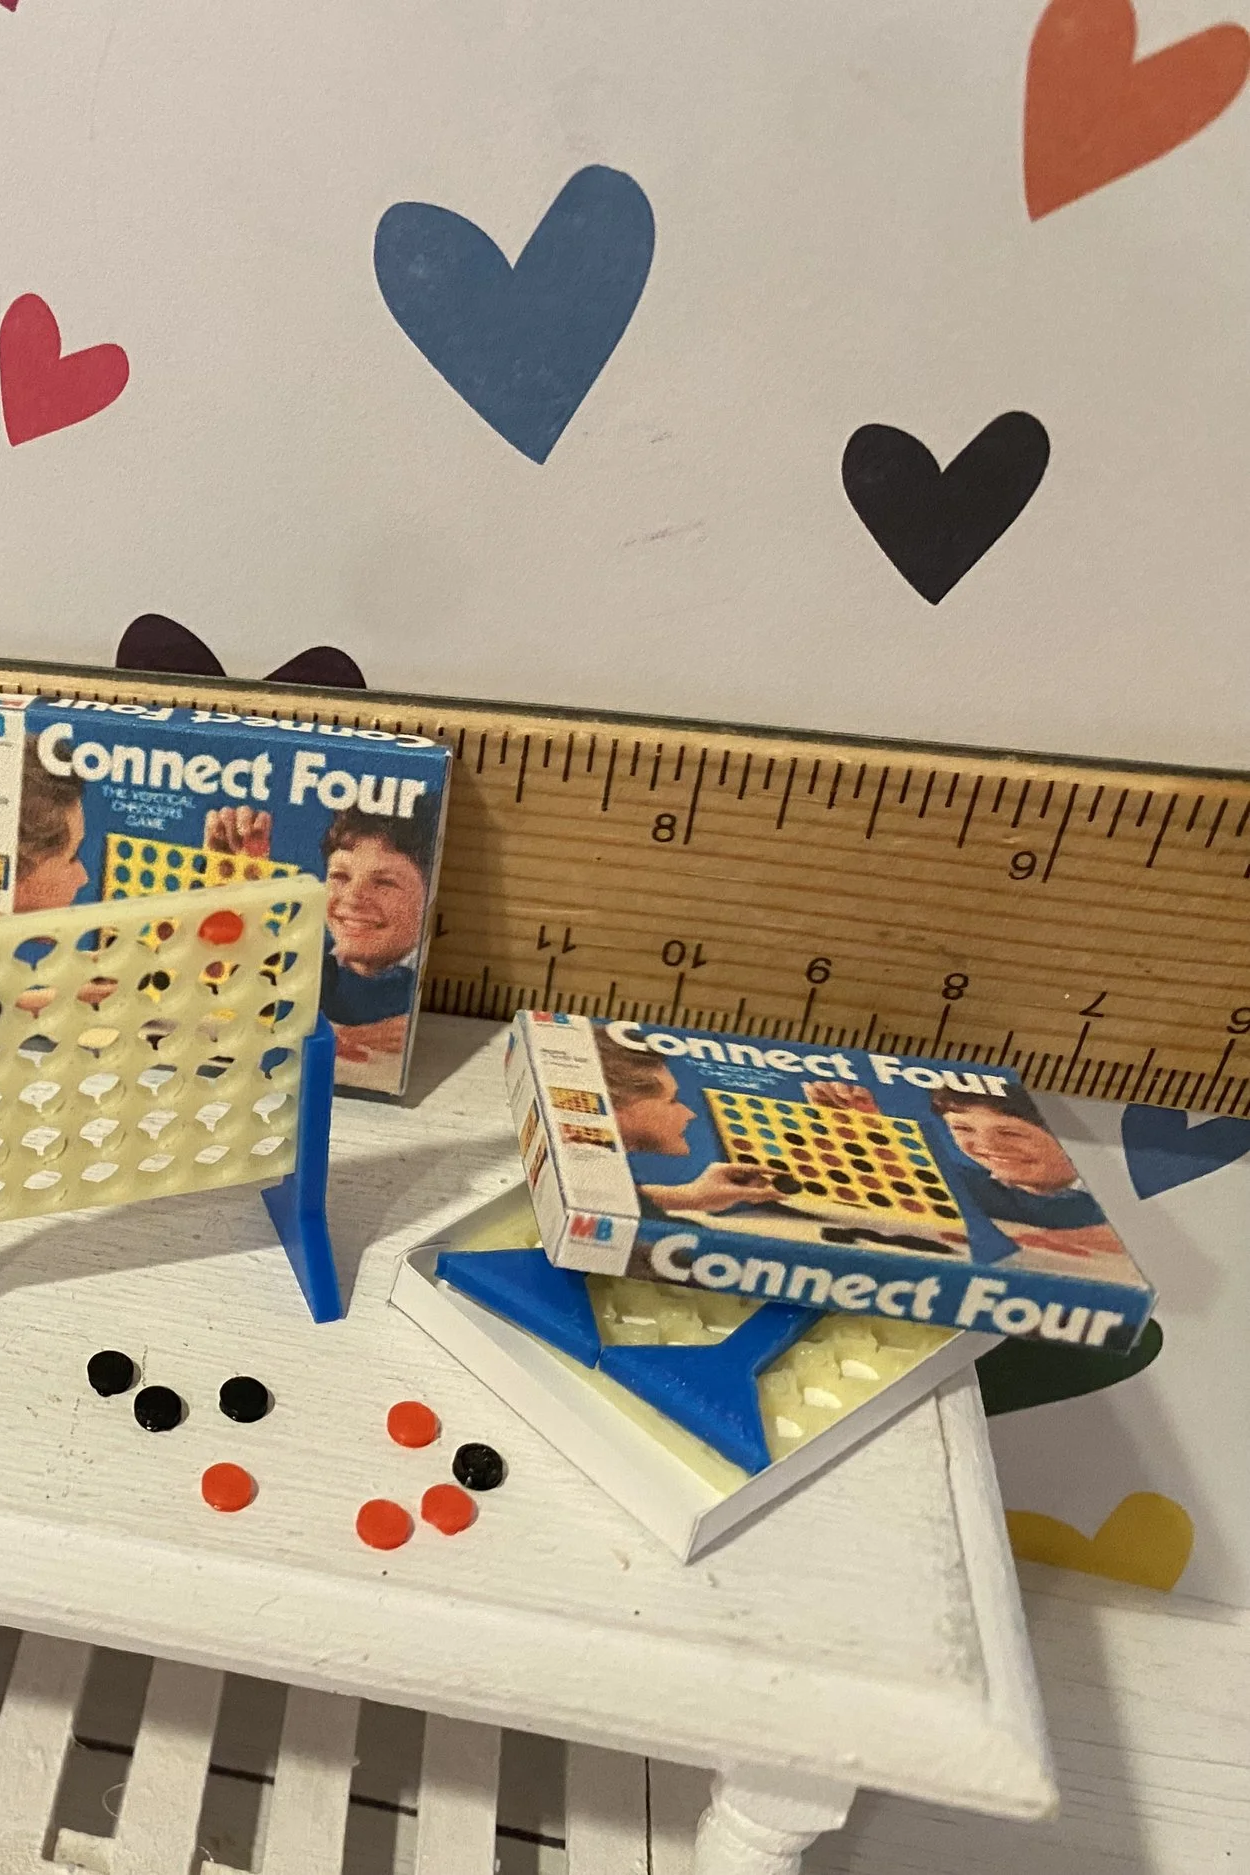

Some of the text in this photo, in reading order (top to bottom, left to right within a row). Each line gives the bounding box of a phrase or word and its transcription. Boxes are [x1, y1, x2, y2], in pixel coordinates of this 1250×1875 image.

[47, 698, 437, 749] Connect Four
[37, 722, 427, 819] Connect Four
[652, 813, 677, 843] 8
[1008, 850, 1038, 880] 9
[537, 925, 576, 954] 11
[661, 940, 707, 969] 10
[806, 956, 832, 984] 9
[941, 972, 969, 1001] 8
[1079, 991, 1108, 1018] 7
[605, 1020, 860, 1081] Connect
[868, 1053, 1008, 1098] Four
[569, 1214, 614, 1242] MB
[650, 1233, 1124, 1347] Connect Four
